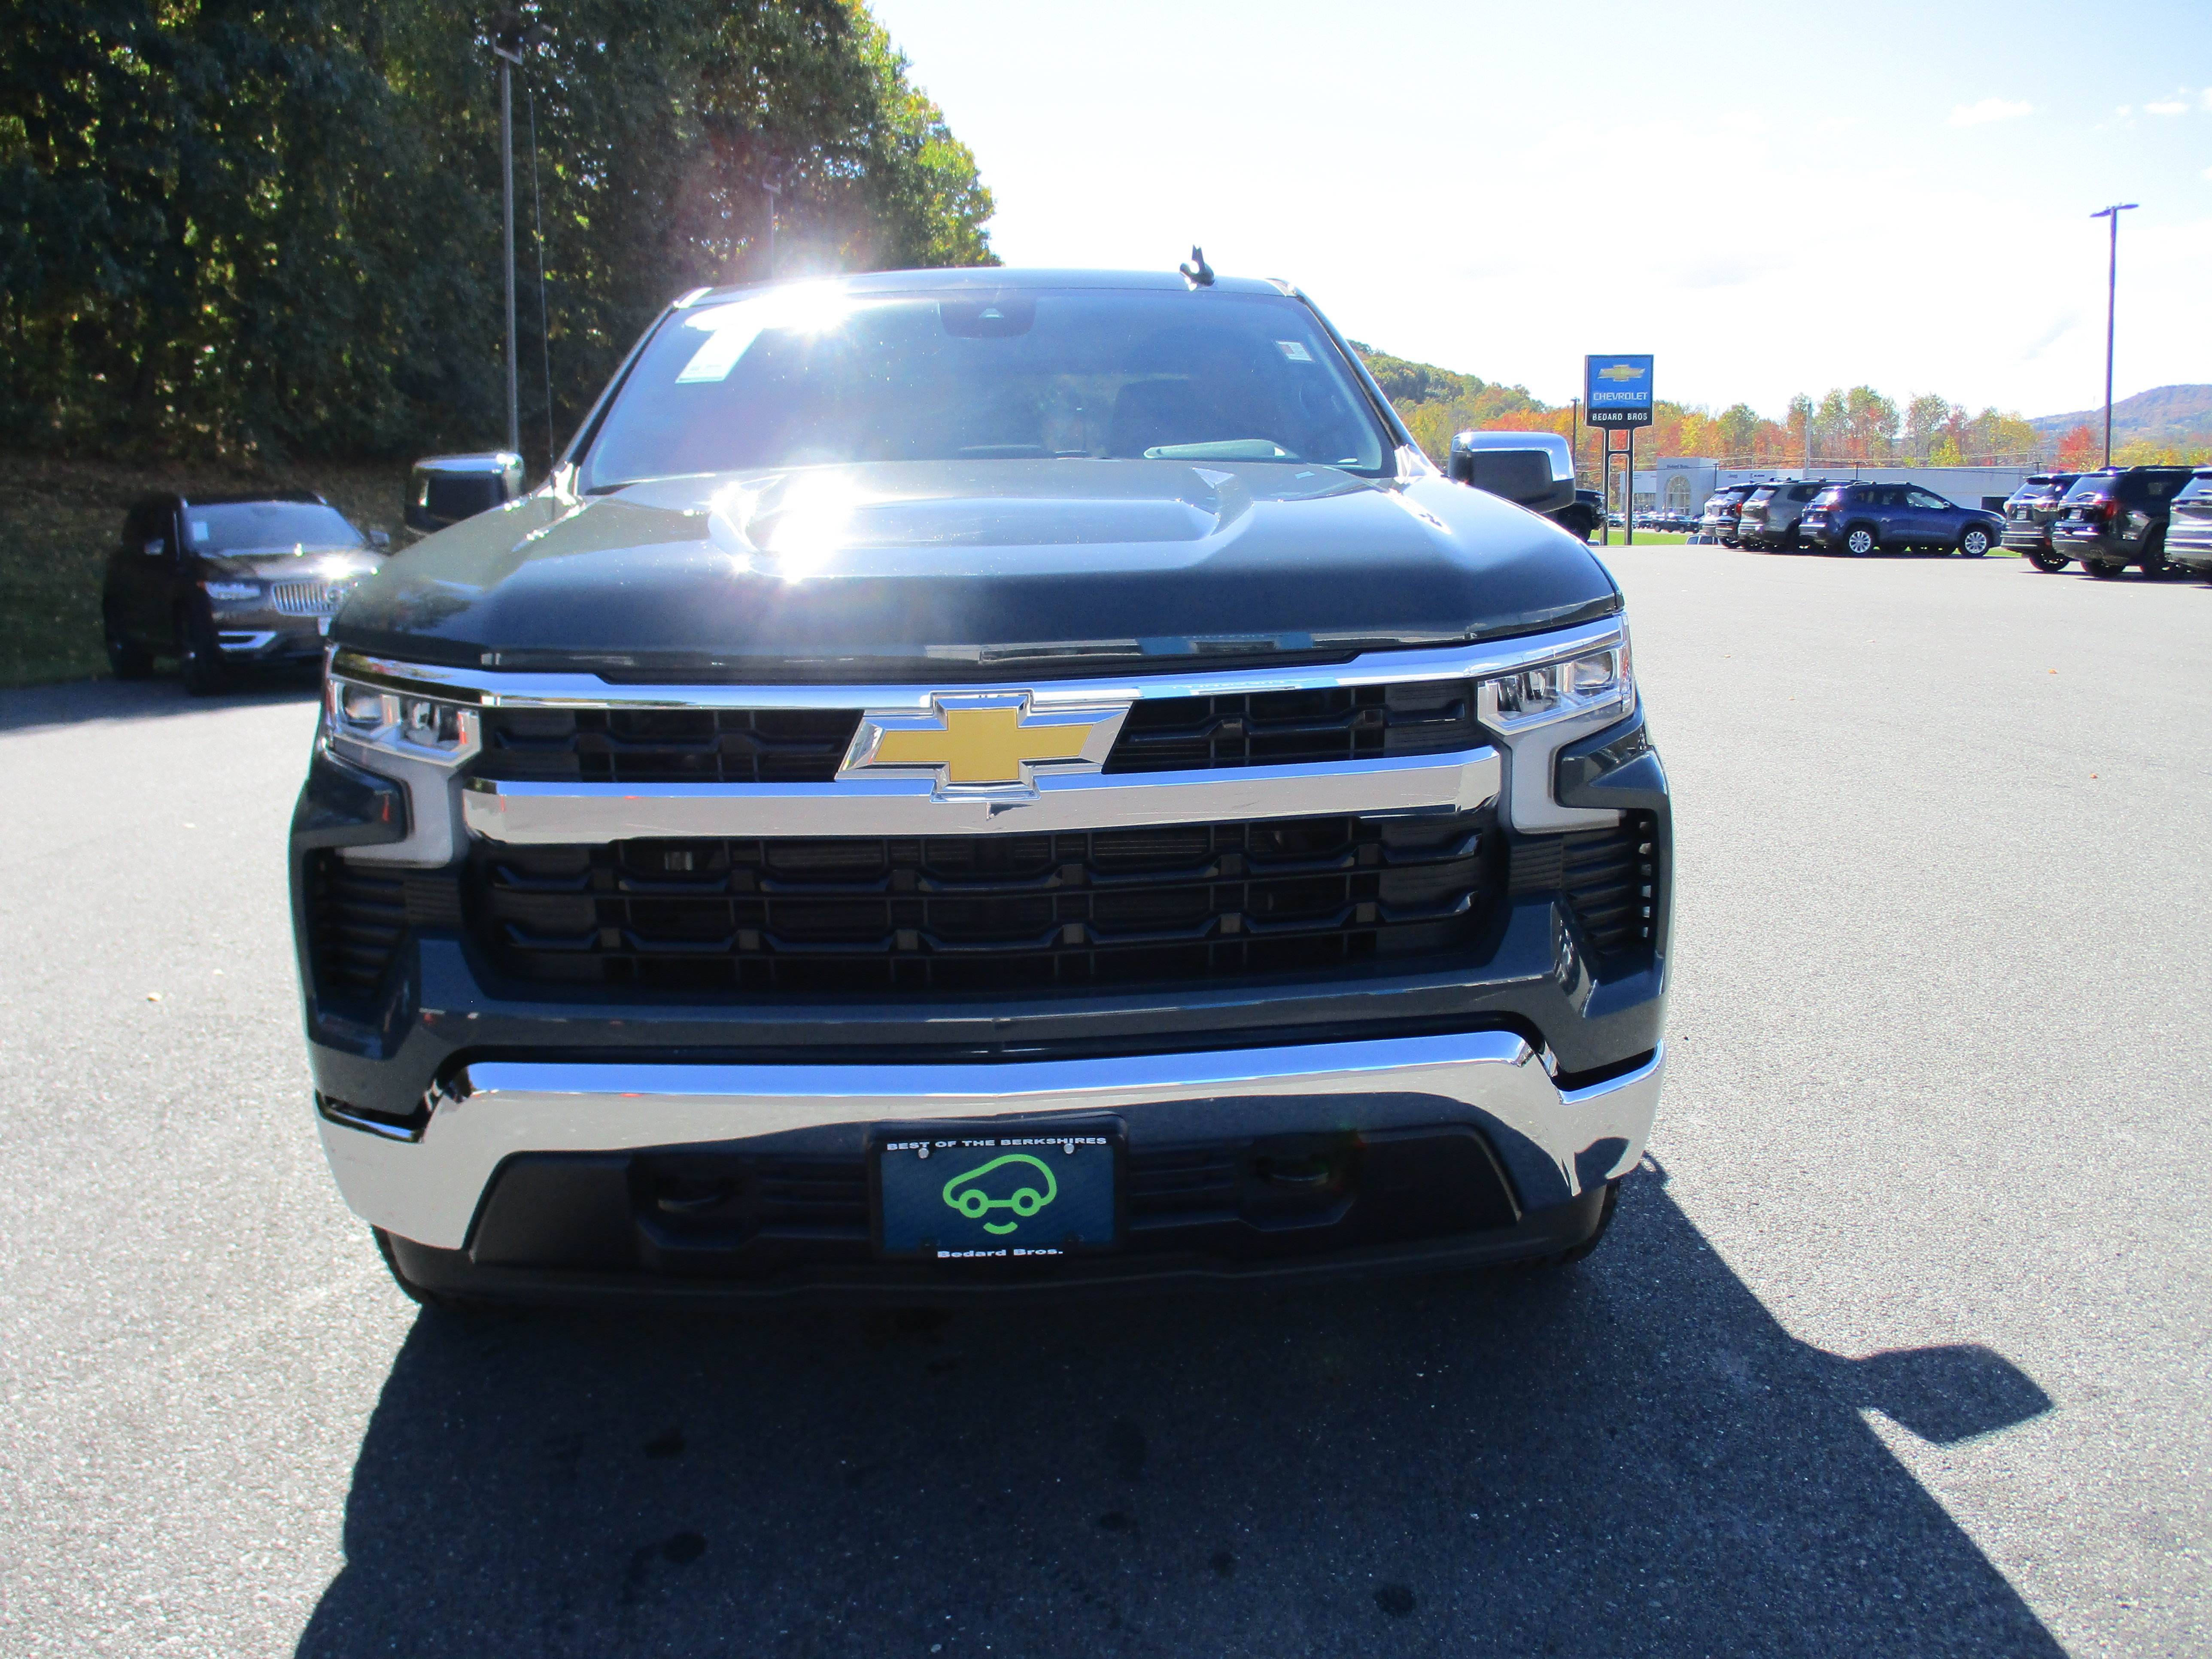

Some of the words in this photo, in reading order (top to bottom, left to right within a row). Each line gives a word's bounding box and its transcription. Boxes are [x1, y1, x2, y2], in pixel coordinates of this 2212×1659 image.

[1593, 392, 1648, 400] CHEVROLET
[1592, 413, 1623, 421] BEDARD
[887, 1142, 930, 1151] BEST
[937, 1249, 1006, 1258] Bedard
